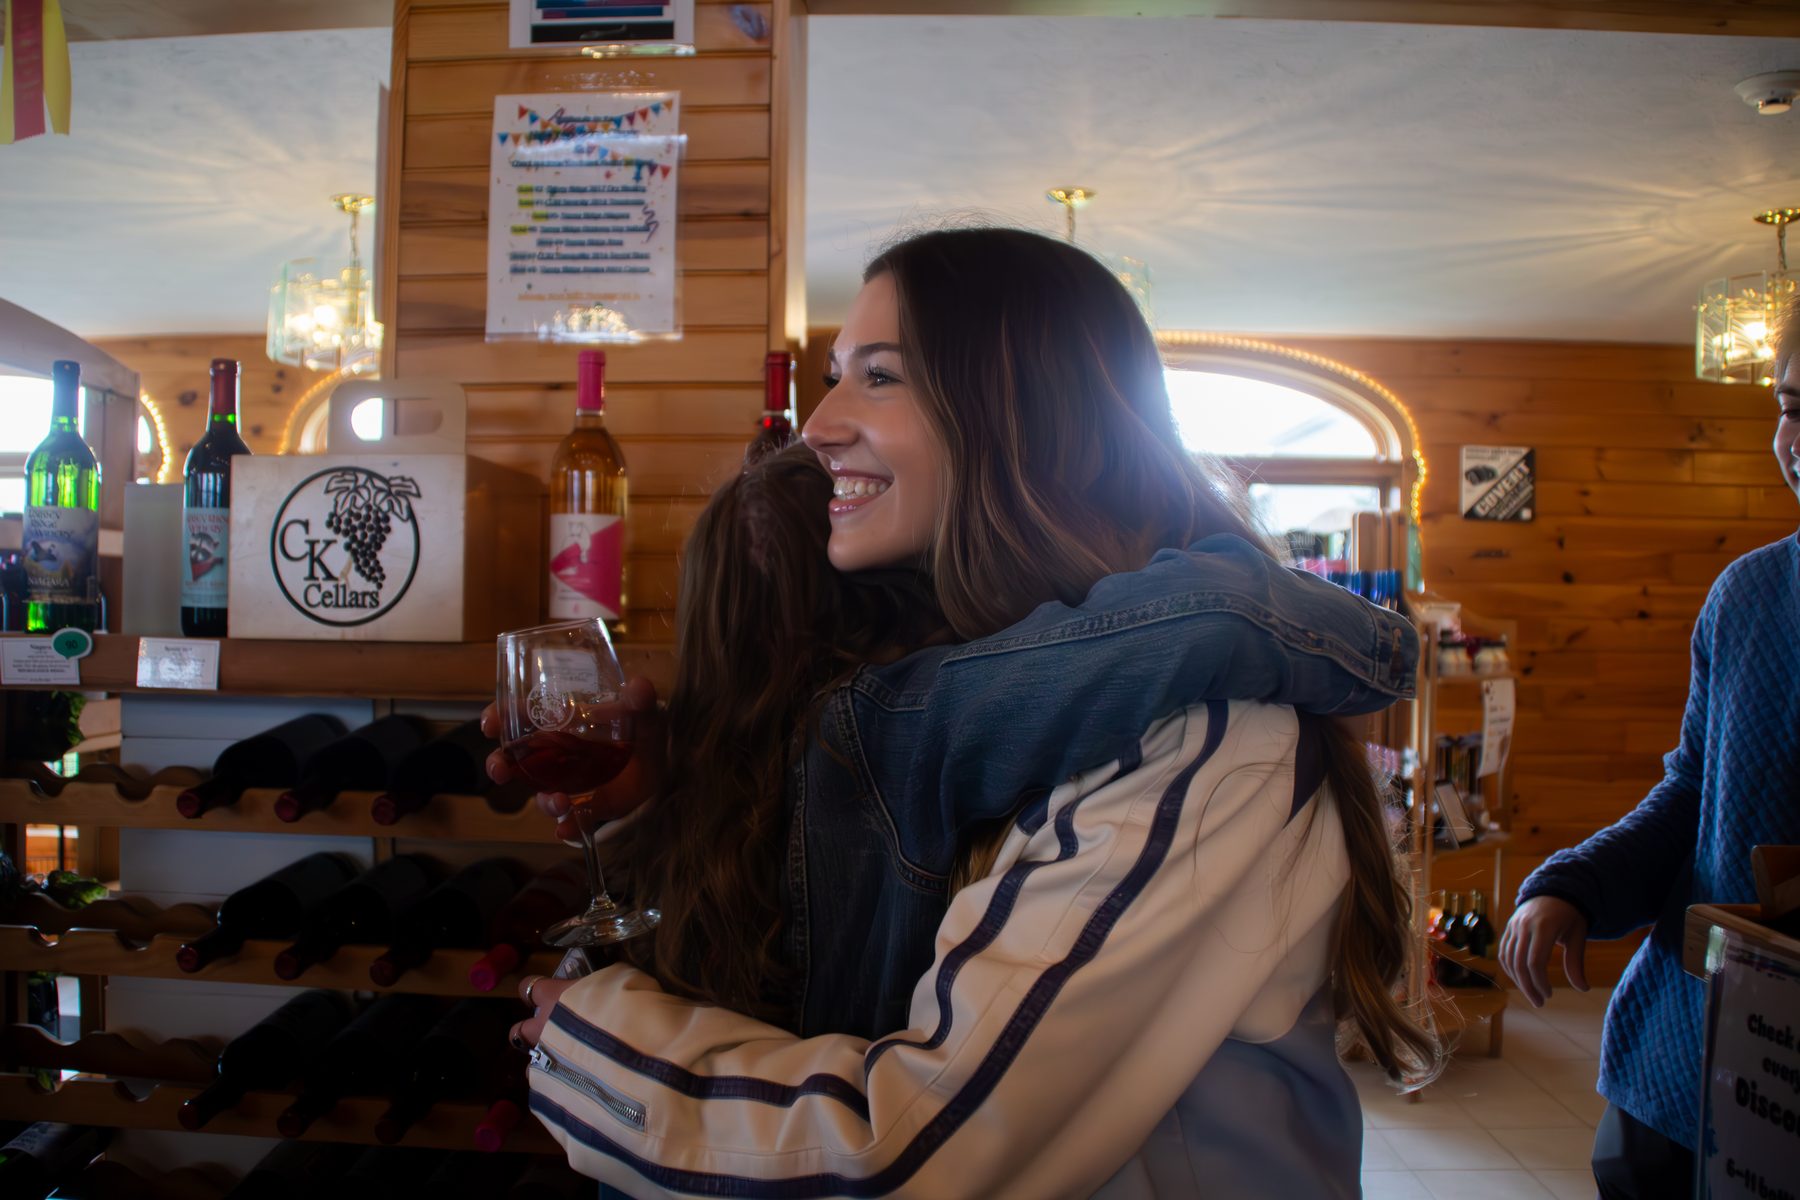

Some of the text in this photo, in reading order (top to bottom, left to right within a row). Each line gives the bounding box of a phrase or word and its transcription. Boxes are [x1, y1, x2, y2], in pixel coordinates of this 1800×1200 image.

[1476, 460, 1530, 516] COVERT
[279, 519, 339, 582] CK
[303, 583, 380, 609] Cellars
[1747, 1013, 1794, 1049] Check
[1736, 1076, 1800, 1138] Disco
